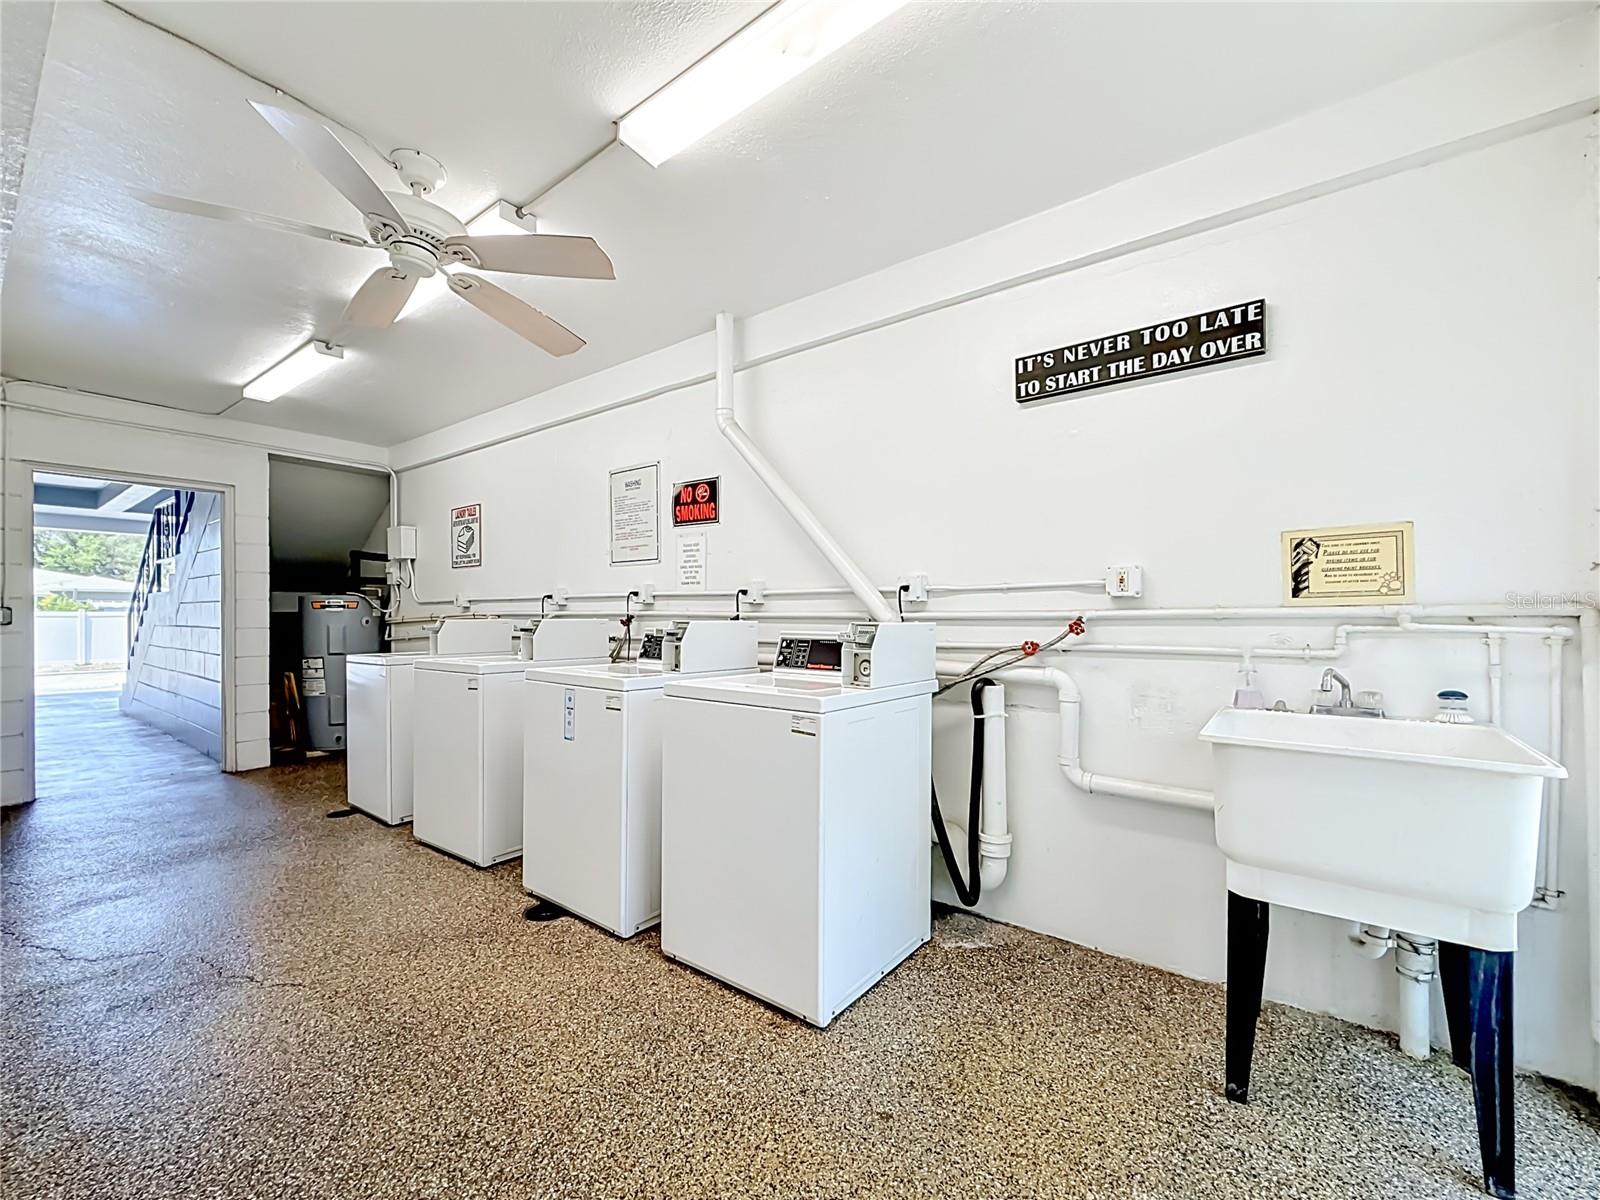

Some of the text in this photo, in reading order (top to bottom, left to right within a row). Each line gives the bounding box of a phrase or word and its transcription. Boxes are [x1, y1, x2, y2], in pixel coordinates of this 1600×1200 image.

[1017, 302, 1263, 374] IT'S NEVER TOO LATE
[1018, 332, 1263, 397] TO START THE DAY OVER
[676, 503, 715, 521] SMOKING
[681, 487, 692, 503] NO
